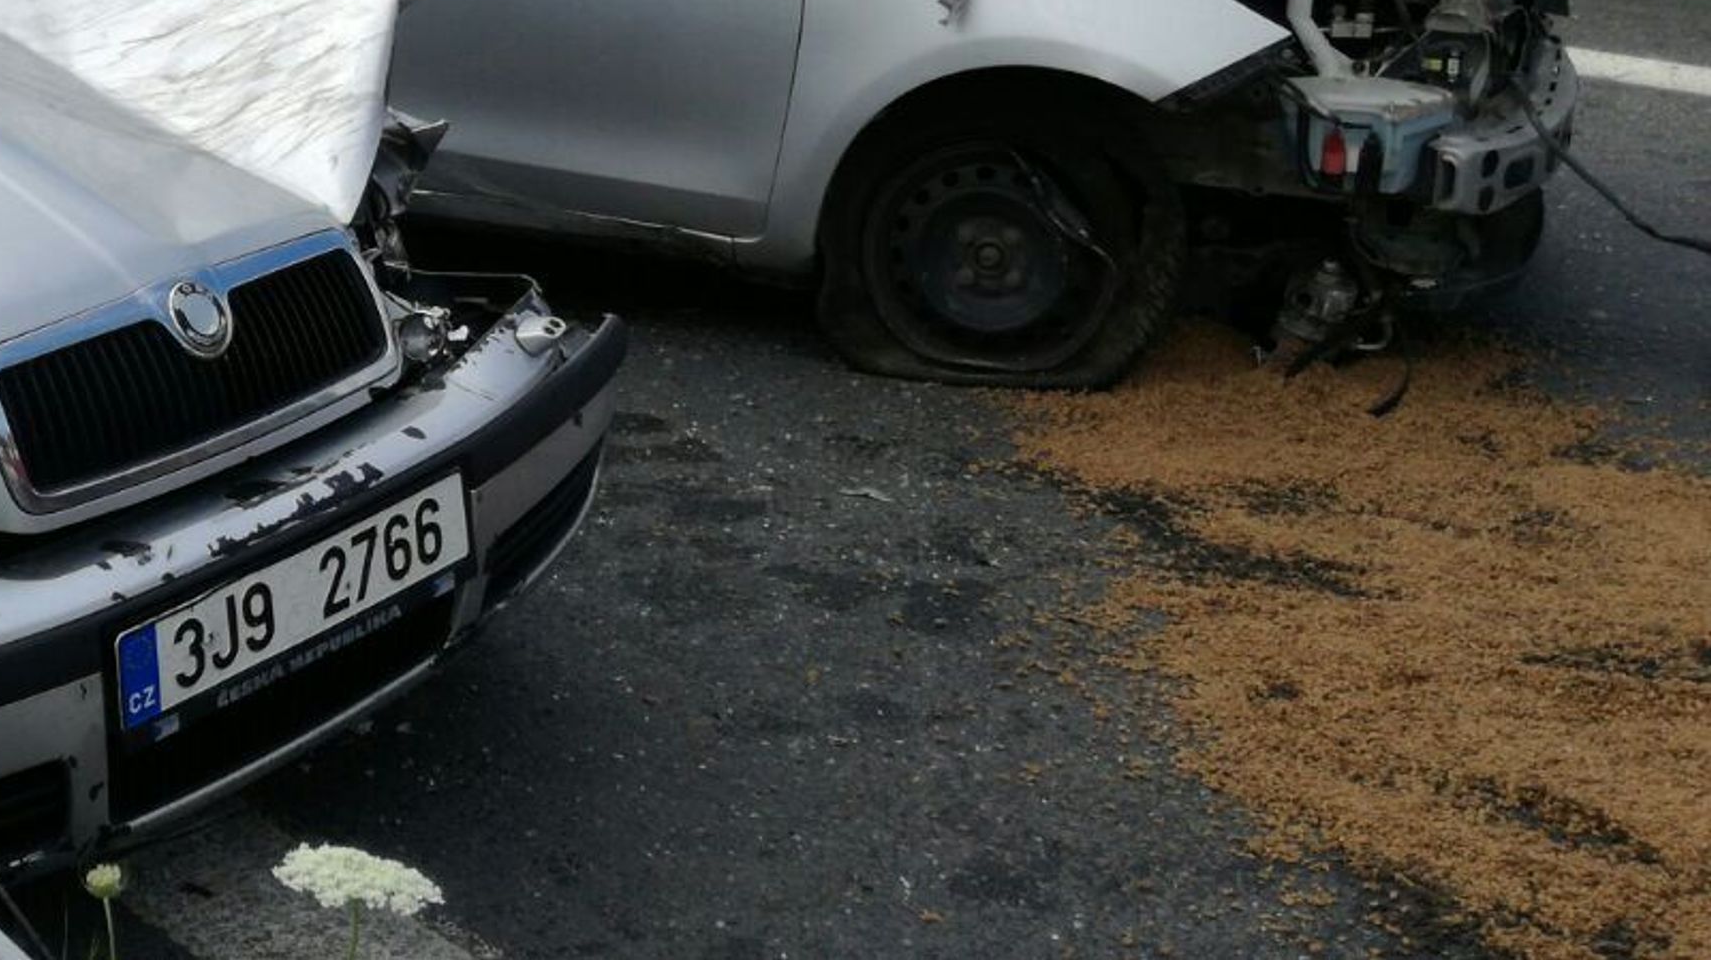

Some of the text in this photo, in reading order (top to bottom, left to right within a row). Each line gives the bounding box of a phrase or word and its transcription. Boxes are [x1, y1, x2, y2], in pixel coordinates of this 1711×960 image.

[173, 498, 444, 689] 3J9 2766
[129, 685, 156, 714] CZ
